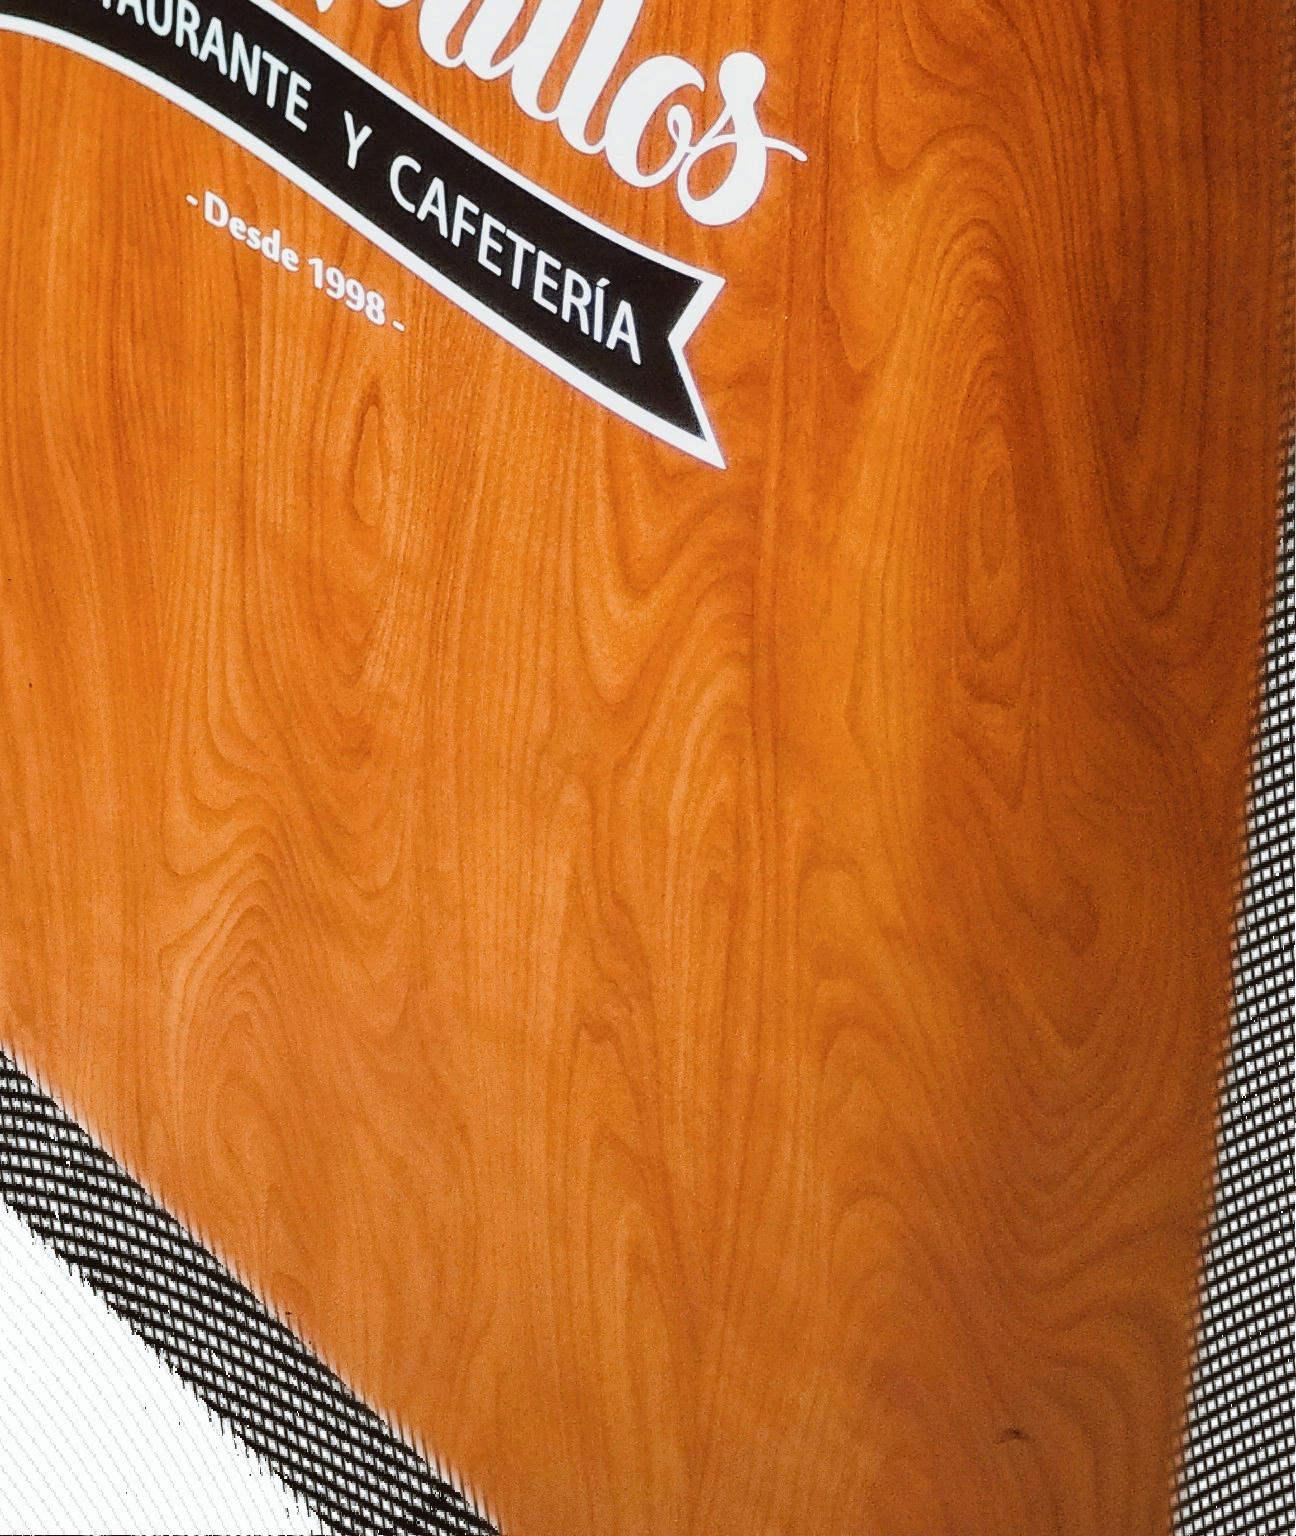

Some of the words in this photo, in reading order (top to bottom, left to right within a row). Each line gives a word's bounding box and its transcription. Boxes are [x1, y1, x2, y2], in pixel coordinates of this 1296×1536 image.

[203, 189, 300, 273] Desde
[307, 256, 387, 327] 1998
[342, 109, 373, 171] Y
[388, 153, 643, 366] CAFETERÍA
